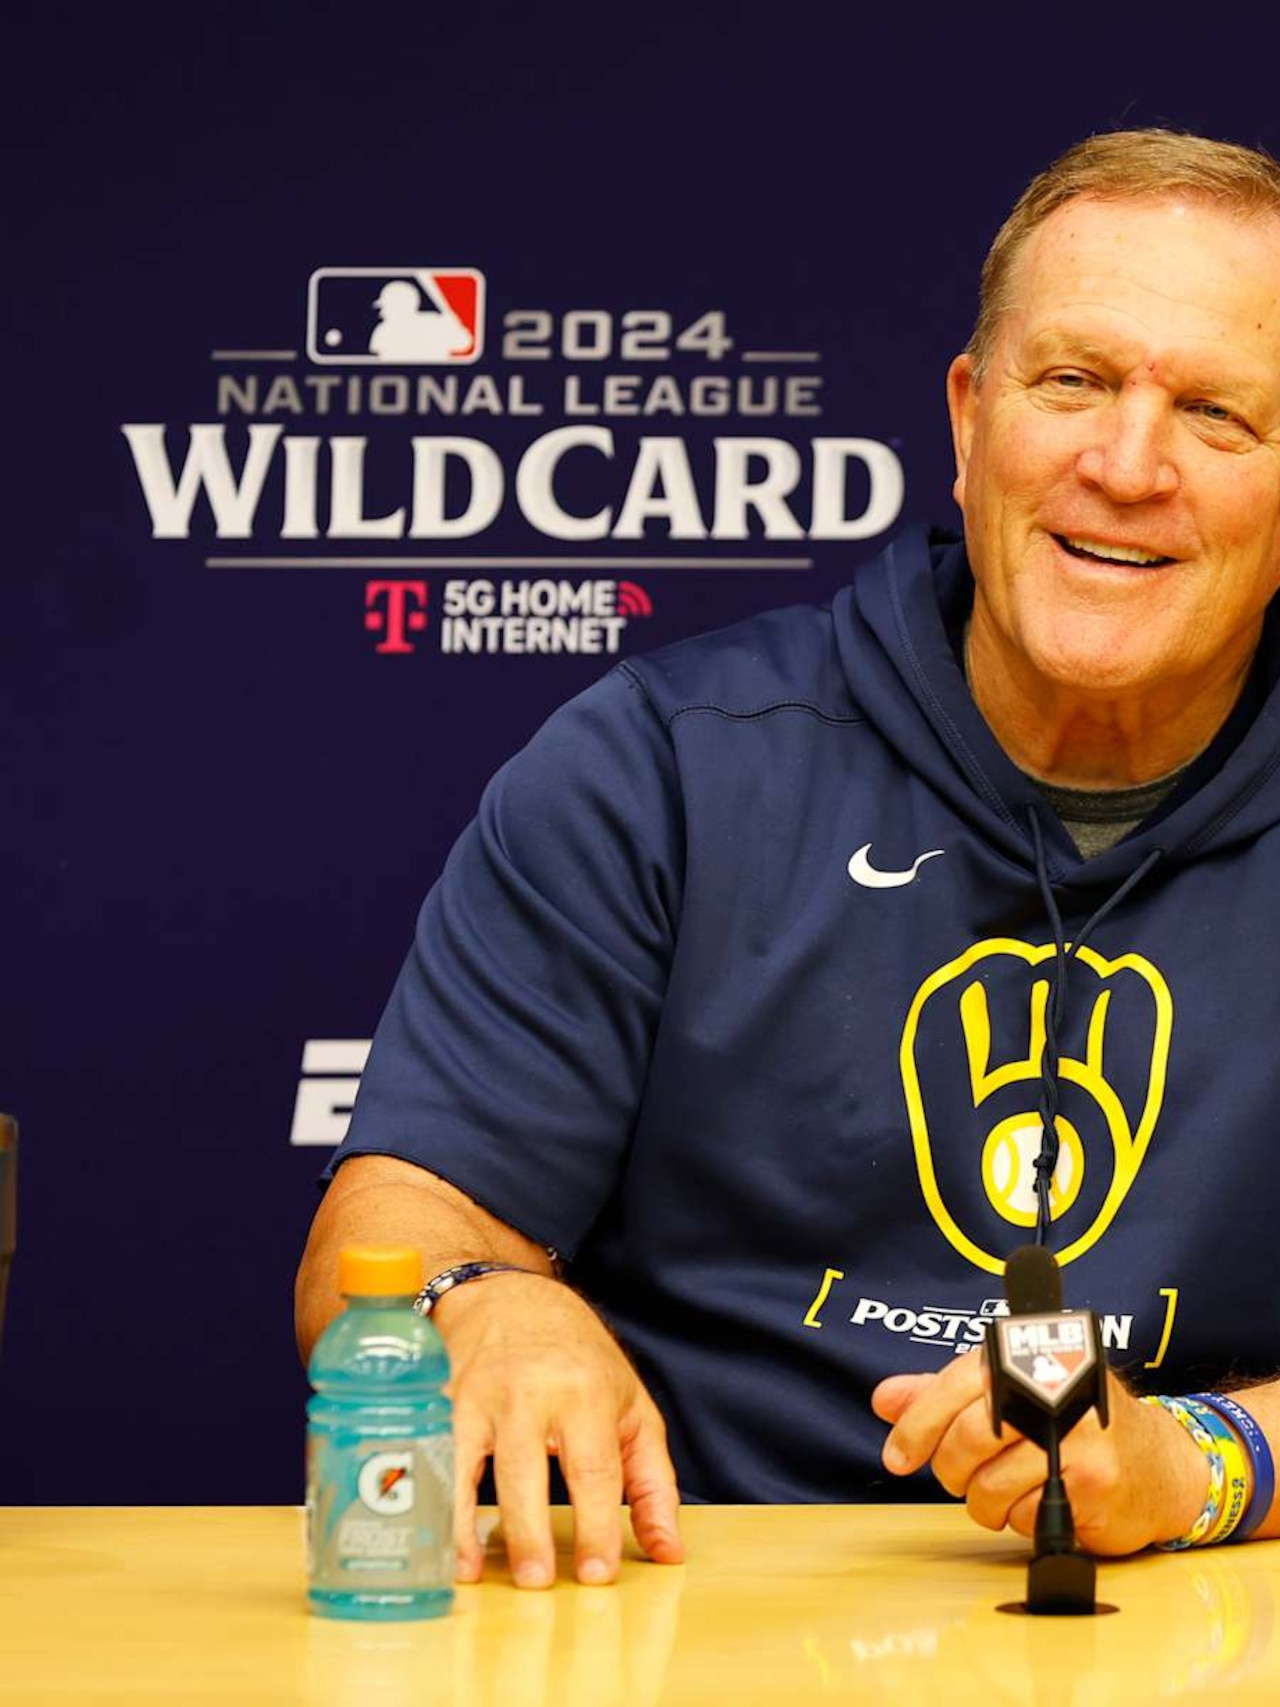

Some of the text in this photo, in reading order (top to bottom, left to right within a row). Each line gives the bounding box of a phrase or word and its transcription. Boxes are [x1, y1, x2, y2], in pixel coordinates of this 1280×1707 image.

[503, 310, 732, 360] 2024
[217, 375, 822, 415] NATIONAL LEAGUE
[443, 579, 616, 616] 5G HOME
[441, 616, 627, 653] INTERNET
[1008, 1320, 1084, 1349] MLB
[358, 1452, 414, 1515] G
